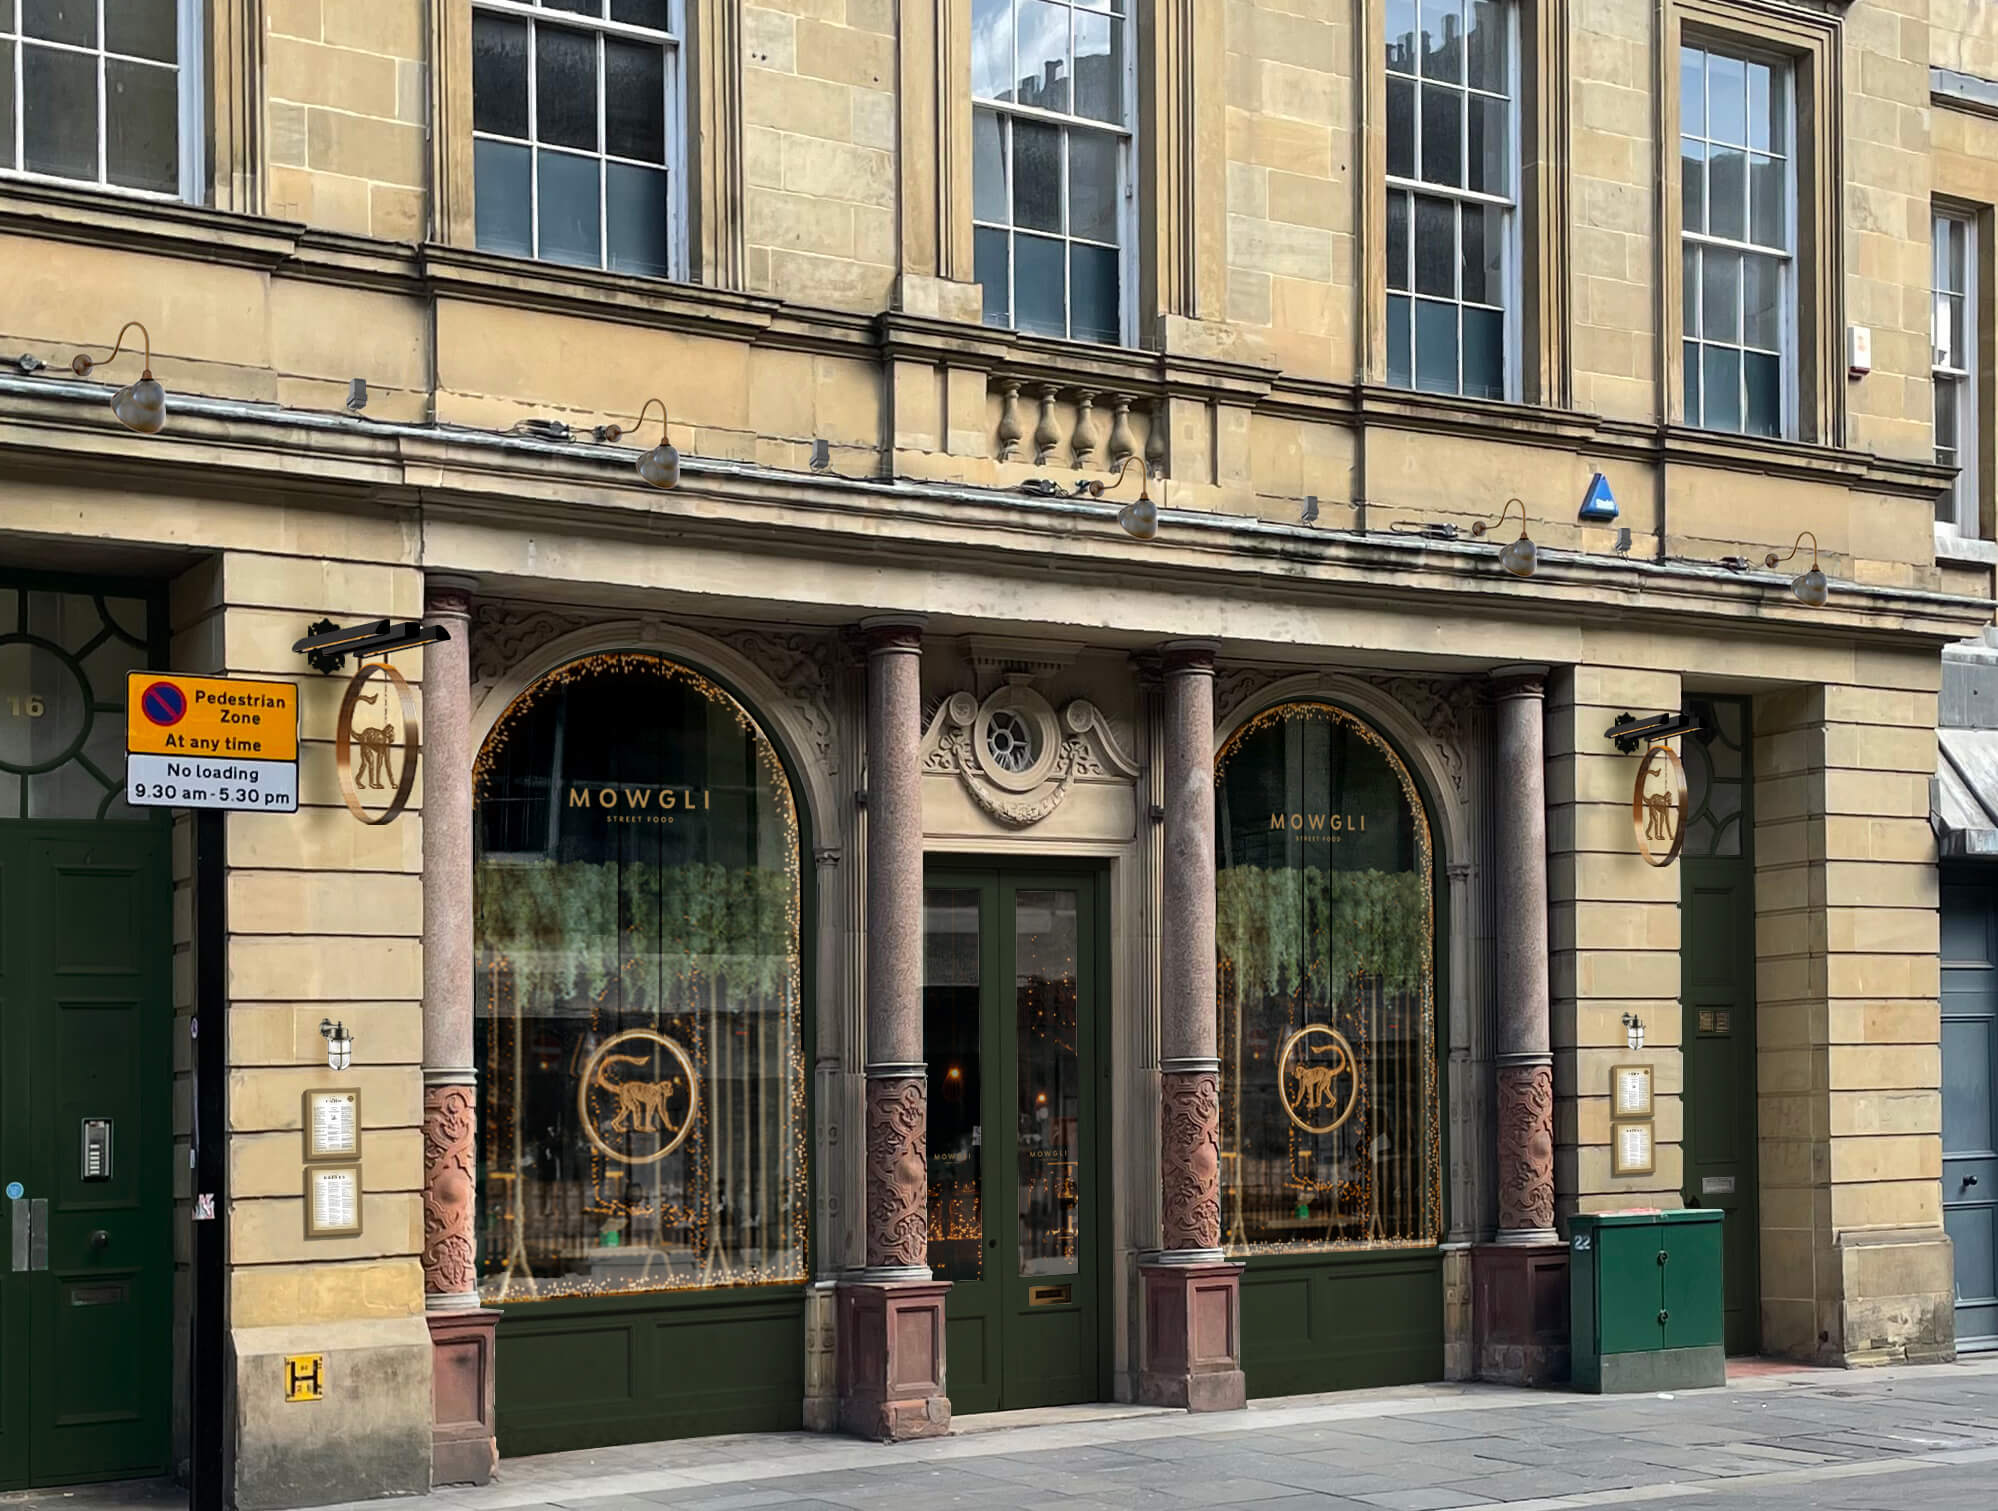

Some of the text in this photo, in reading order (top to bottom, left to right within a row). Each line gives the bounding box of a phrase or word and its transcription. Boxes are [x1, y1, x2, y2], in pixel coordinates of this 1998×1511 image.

[8, 695, 45, 718] 16
[195, 690, 286, 708] Pedestrian
[220, 709, 261, 725] Zone
[165, 733, 261, 752] At any time
[167, 763, 259, 783] No loading
[135, 783, 177, 799] 9.30
[264, 793, 290, 806] pm
[569, 787, 710, 810] MOWGLI
[1270, 812, 1365, 832] MOWGLI
[1574, 1234, 1591, 1250] 22
